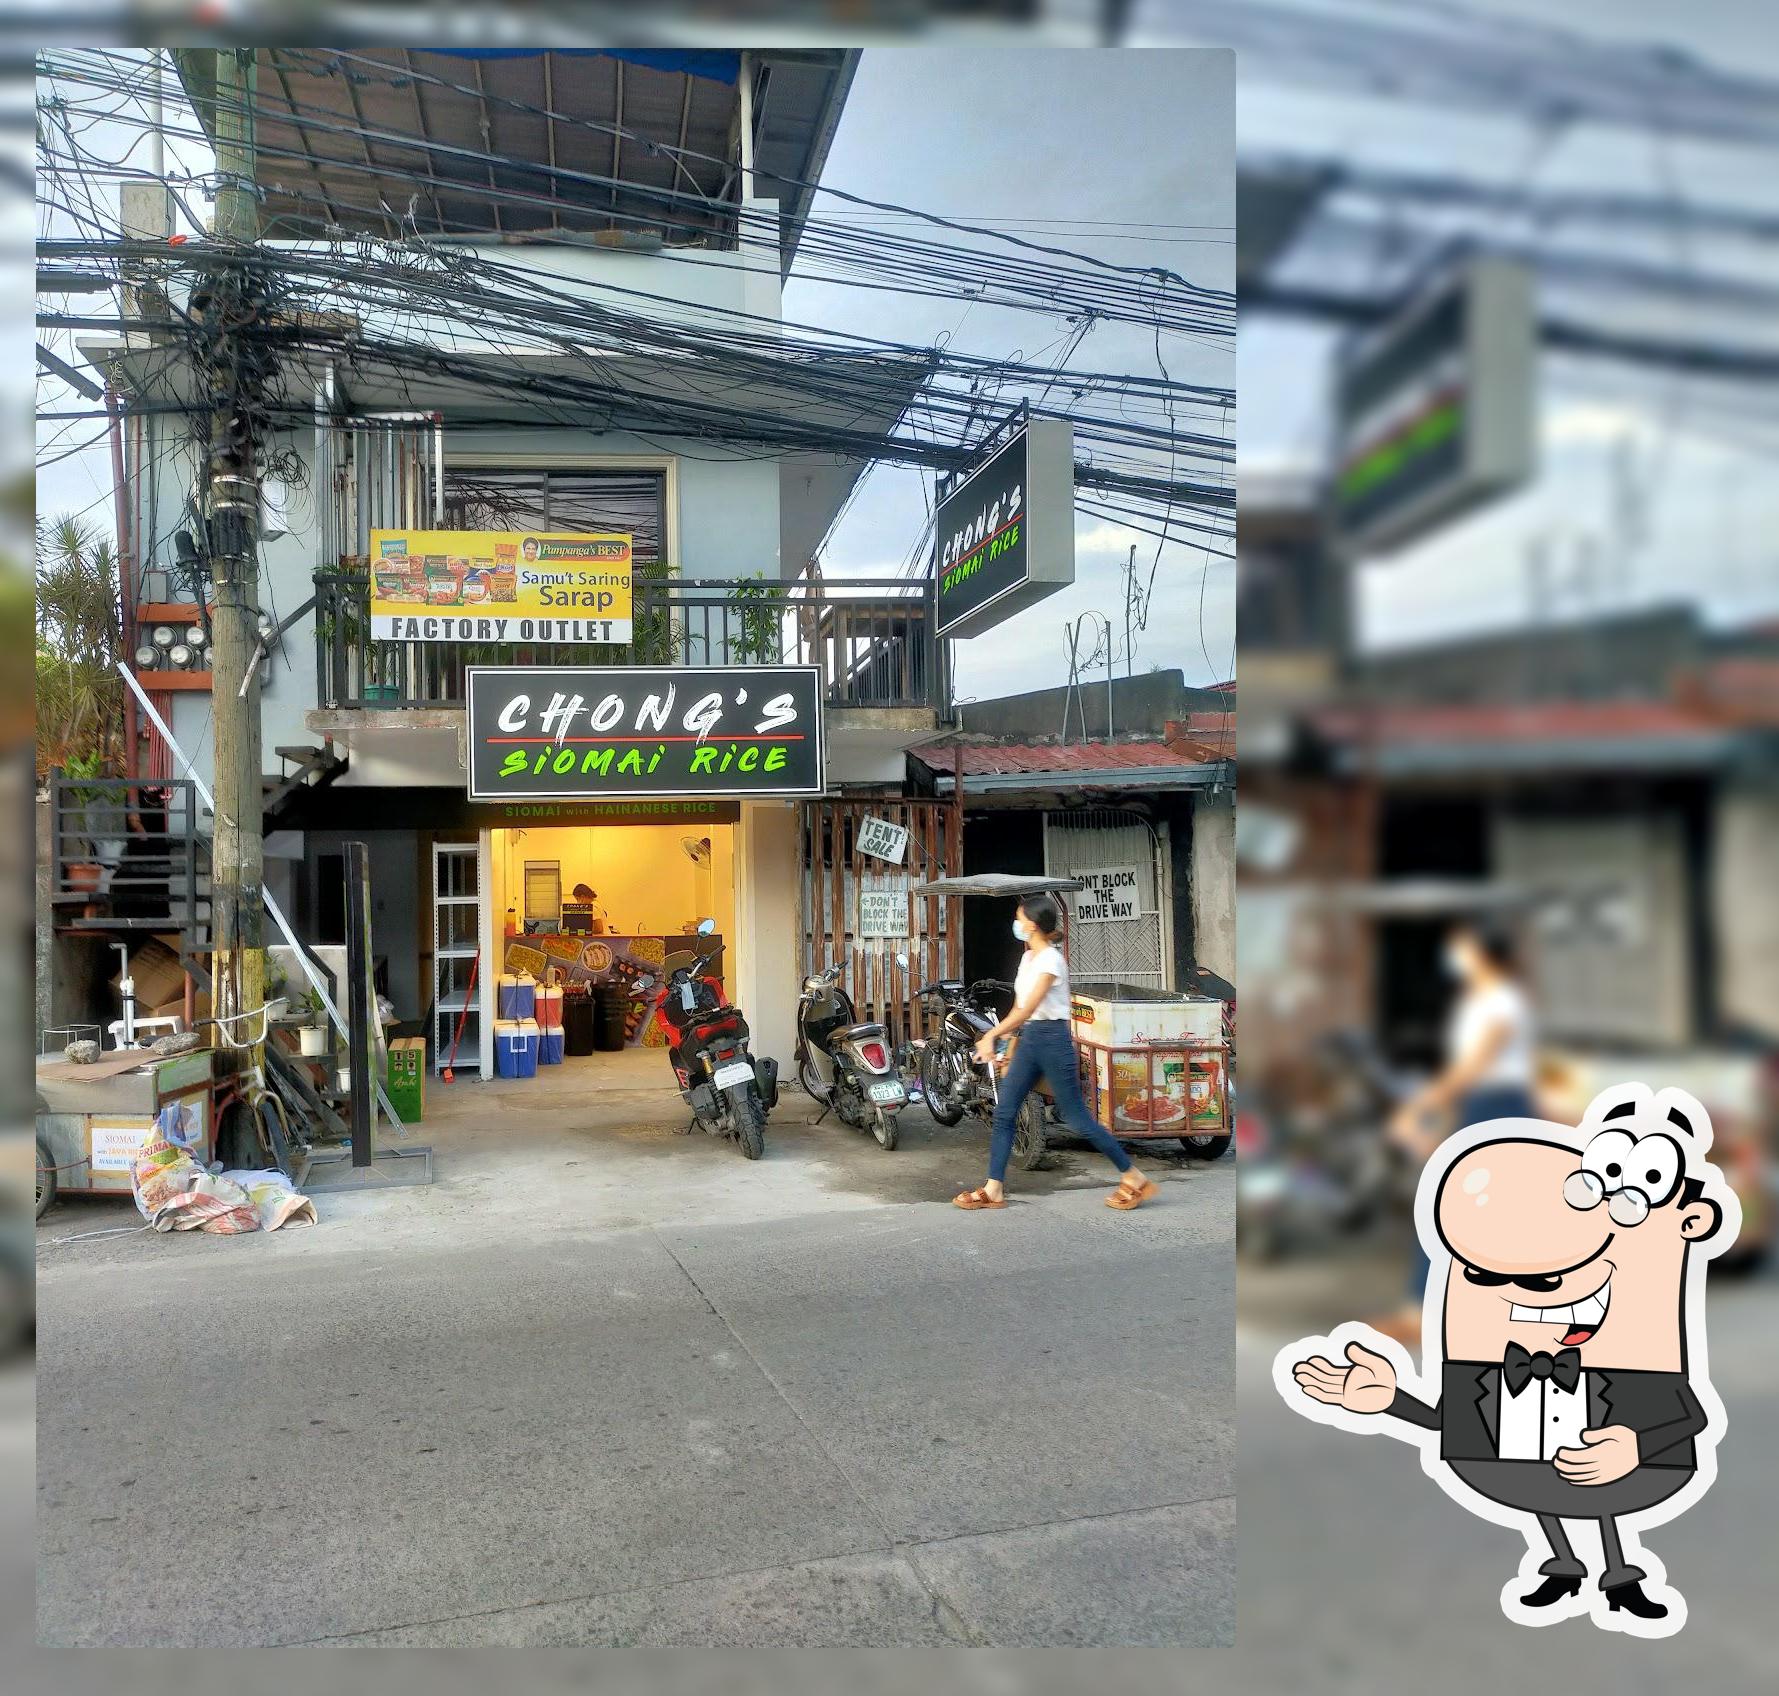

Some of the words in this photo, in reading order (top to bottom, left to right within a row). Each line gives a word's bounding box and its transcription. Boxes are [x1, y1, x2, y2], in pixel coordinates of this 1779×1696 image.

[942, 485, 1021, 567] CHONG'S
[542, 544, 595, 557] Pampanga's
[597, 544, 626, 556] BEST
[522, 571, 574, 585] Samu't
[578, 572, 630, 589] Saring
[539, 586, 613, 612] Sarap
[391, 617, 508, 641] FACTORY
[519, 619, 612, 641] OUTLET
[498, 682, 798, 748] CHONG'S
[505, 805, 561, 817] SIOMAI
[566, 807, 589, 816] with
[594, 803, 678, 815] HAINANESE
[682, 802, 716, 813] RICE
[865, 820, 903, 845] TENT
[863, 838, 895, 858] SALE
[1102, 871, 1136, 888] BLOCK
[869, 896, 899, 907] DON'T
[1093, 889, 1115, 903] THE
[863, 908, 889, 919] BLOCK
[892, 909, 908, 919] THE
[1078, 904, 1109, 920] DRIVE
[1110, 902, 1133, 918] WAY
[862, 922, 887, 932] DRIVE
[105, 1135, 136, 1144] SIOMAI
